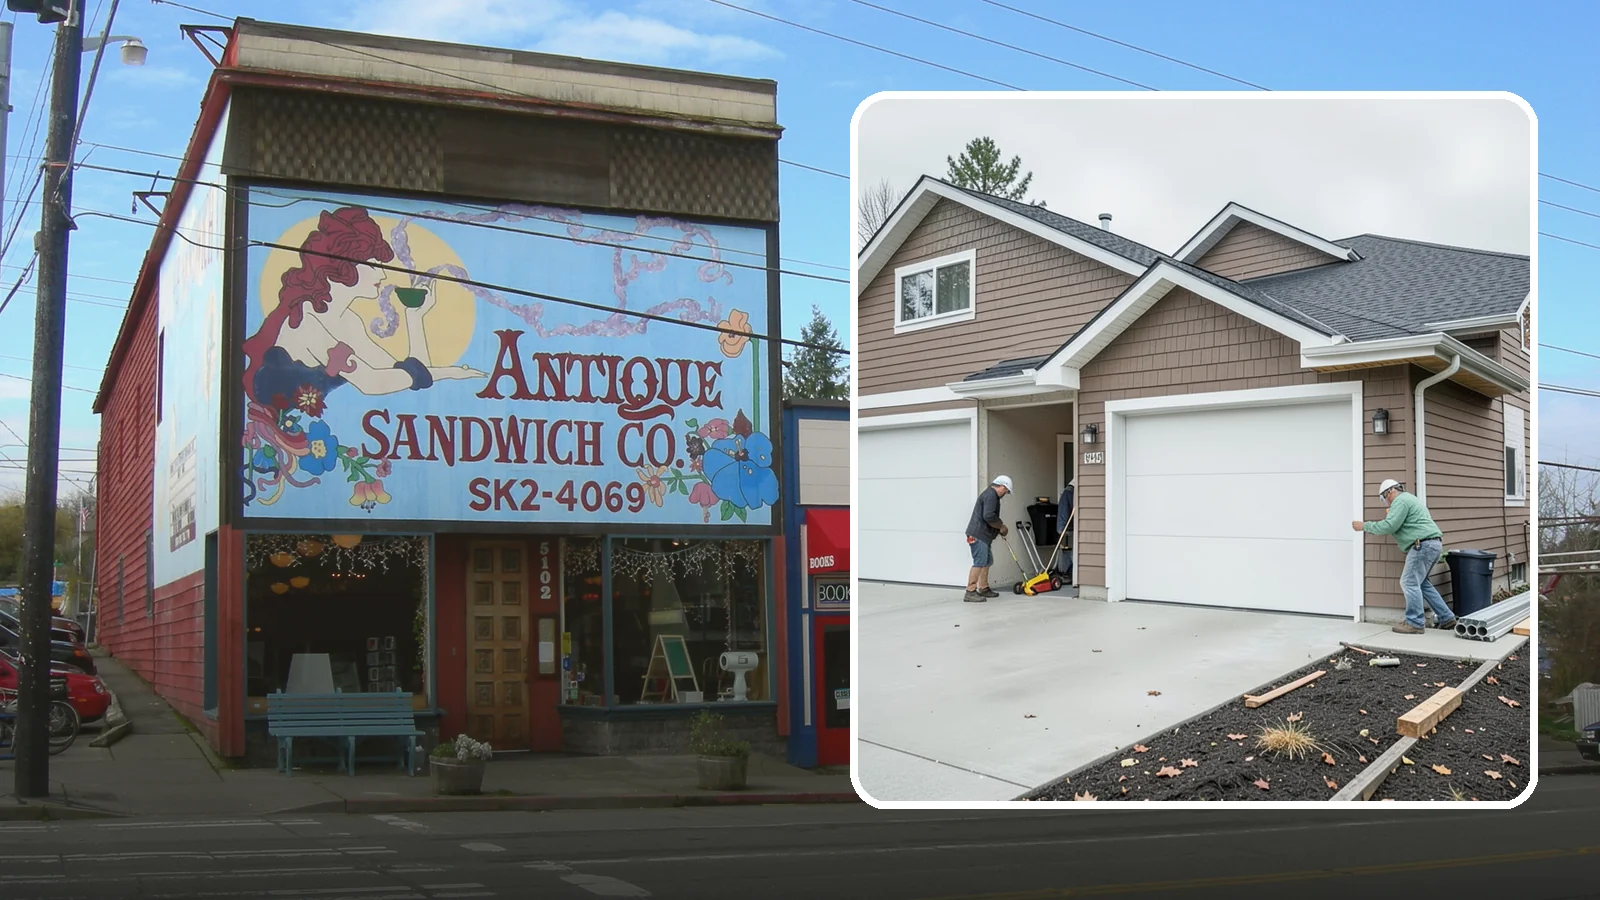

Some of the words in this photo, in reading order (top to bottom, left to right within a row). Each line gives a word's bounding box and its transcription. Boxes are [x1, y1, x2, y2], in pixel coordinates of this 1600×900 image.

[476, 329, 724, 421] ANTIQUE
[361, 408, 604, 467] SANDWICH
[617, 422, 685, 468] CO.
[468, 477, 645, 512] SK2-4069
[539, 542, 552, 600] 5102
[809, 555, 835, 569] BOOKS
